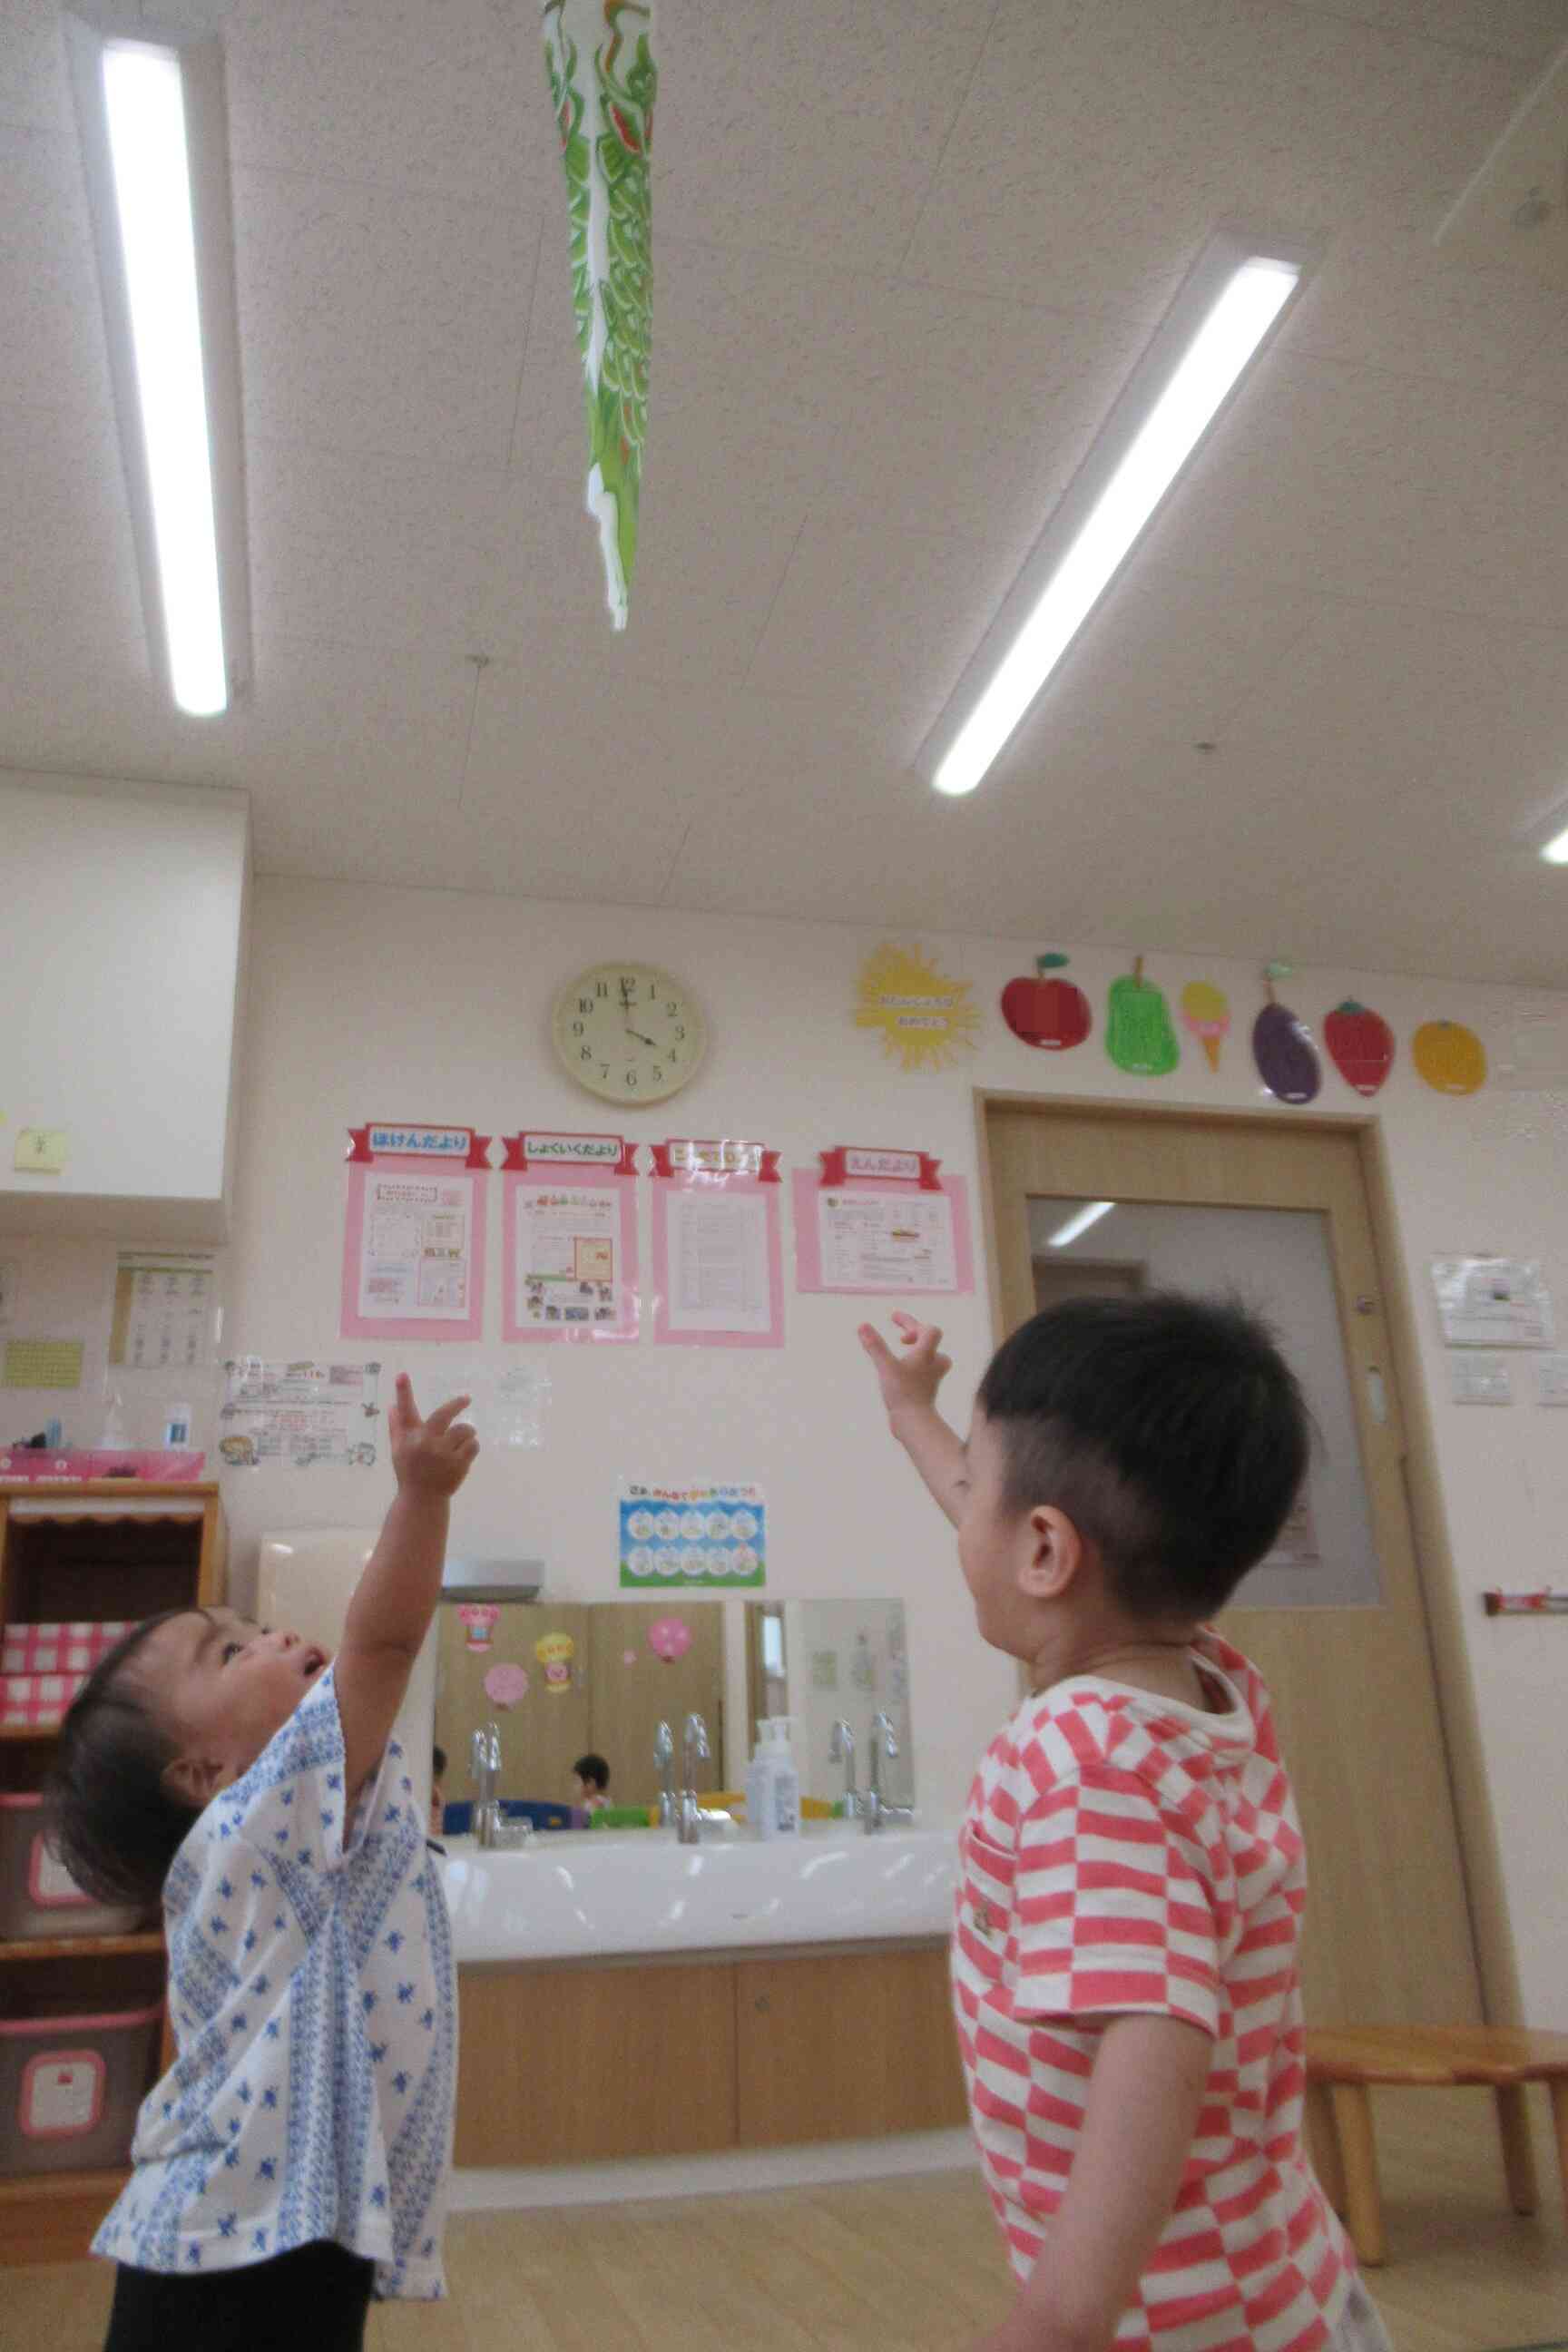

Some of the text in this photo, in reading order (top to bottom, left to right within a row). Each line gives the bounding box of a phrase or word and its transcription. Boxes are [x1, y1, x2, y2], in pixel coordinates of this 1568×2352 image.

[596, 983, 608, 997] 11
[649, 985, 656, 1000] 1
[579, 999, 594, 1014] 10
[667, 1002, 679, 1017] 2
[573, 1022, 585, 1038] 9
[674, 1024, 686, 1041] 3
[580, 1045, 593, 1062] 8
[667, 1048, 677, 1063] 4
[599, 1063, 611, 1080] 7
[625, 1069, 638, 1086] 6
[652, 1065, 662, 1082] 5
[372, 1132, 468, 1151] ほけんだより
[527, 1141, 618, 1157] しょくいくだより
[849, 1156, 917, 1174] えんだより
